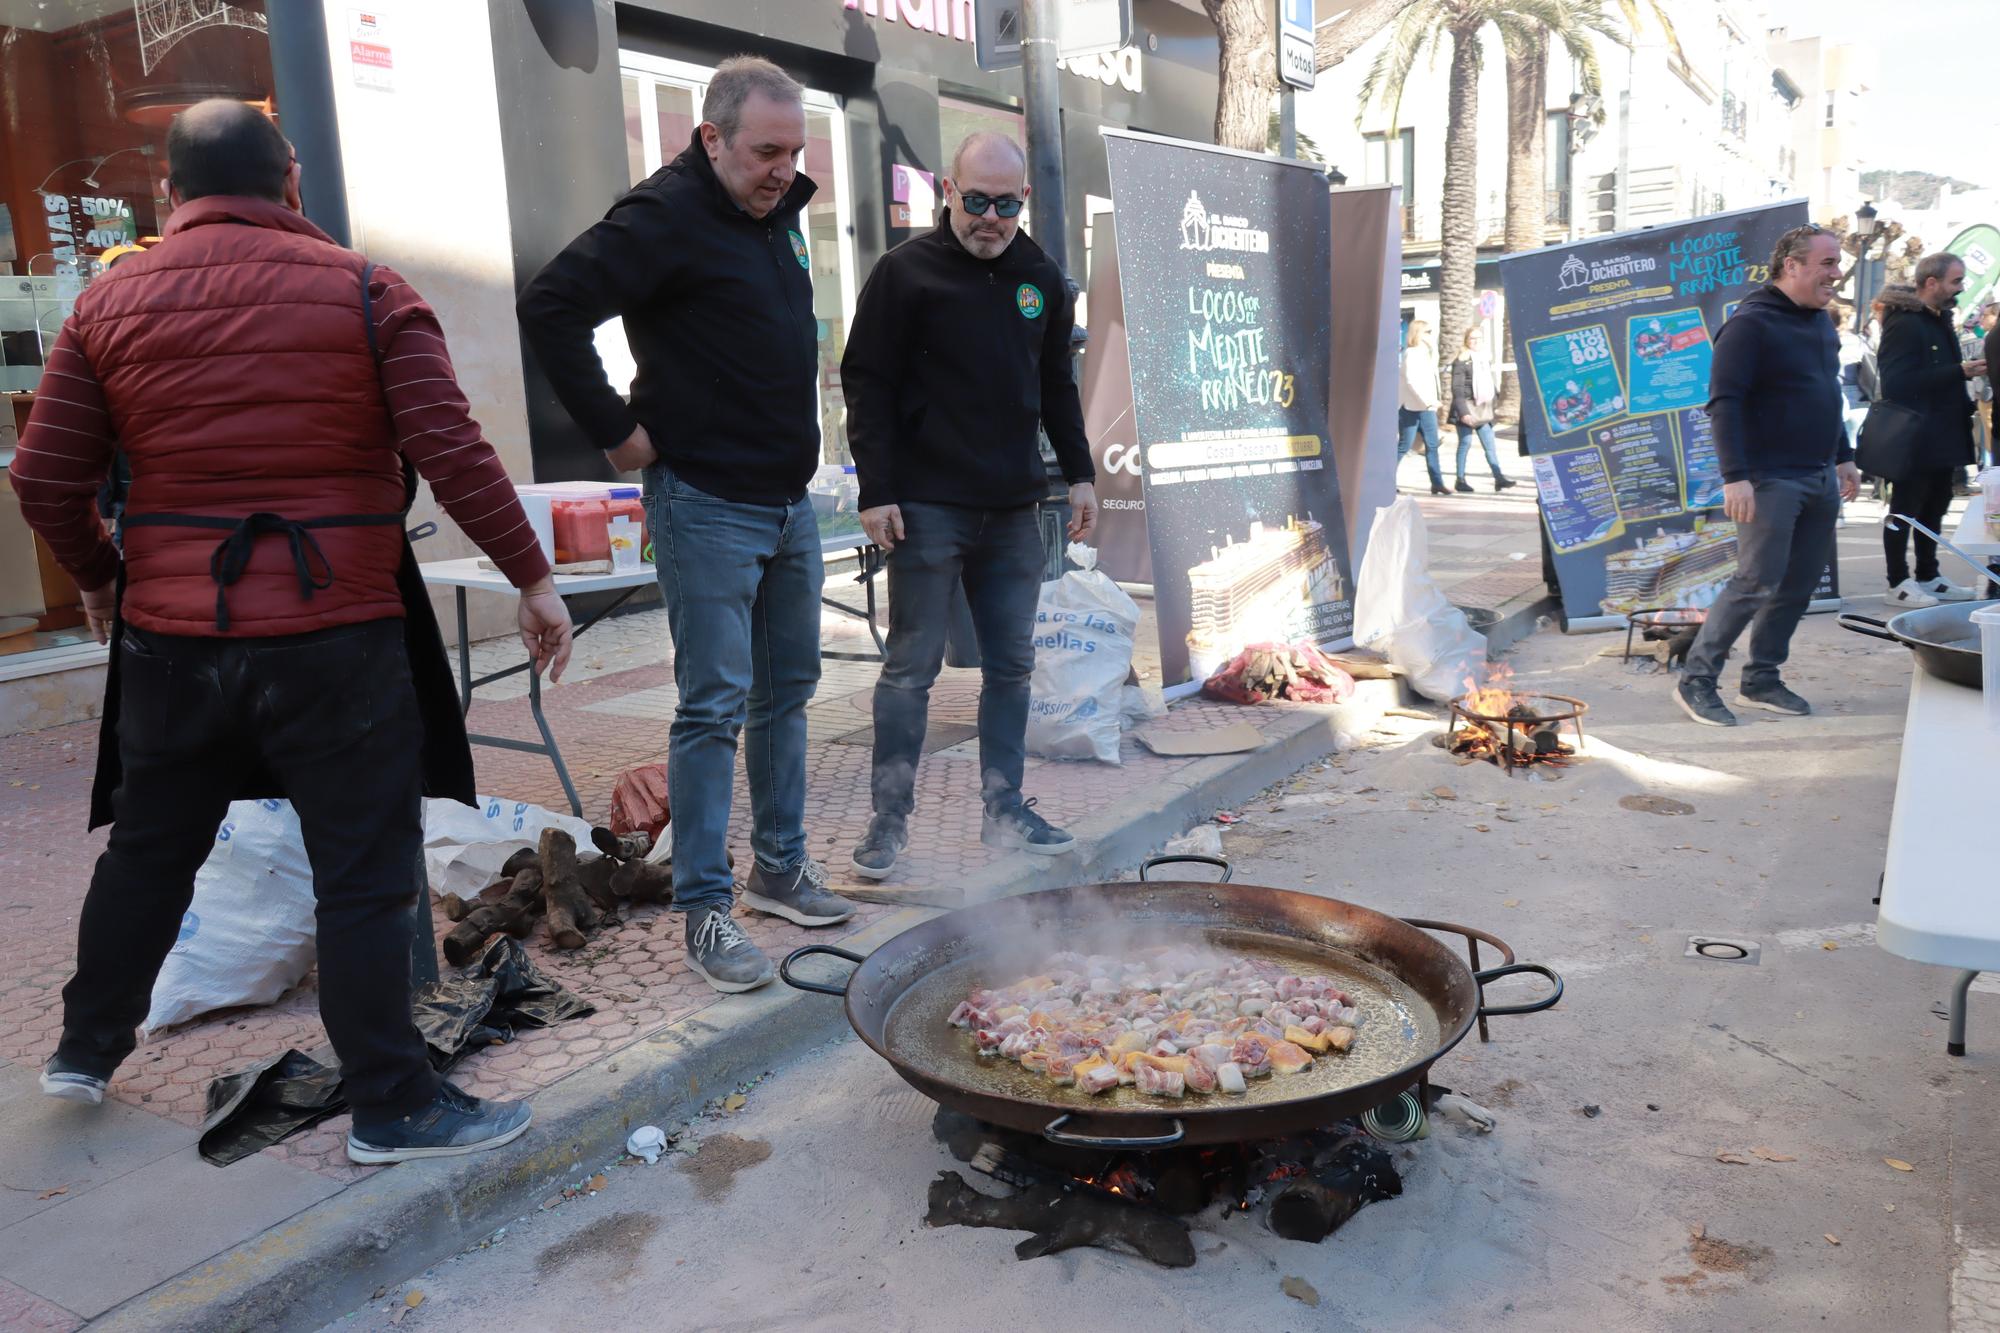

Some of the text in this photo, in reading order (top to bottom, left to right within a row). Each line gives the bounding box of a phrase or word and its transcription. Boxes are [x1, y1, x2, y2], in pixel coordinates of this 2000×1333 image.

[1286, 47, 1312, 74] Motos
[80, 196, 130, 219] 50%
[86, 228, 134, 249] 40%
[1670, 233, 1723, 255] LOCOS
[1592, 257, 1656, 281] OCHENTERO
[1589, 279, 1631, 293] PRESENTA
[1188, 286, 1244, 323] LOCOS
[1565, 327, 1602, 342] PASAJE
[1084, 614, 1116, 634] las
[1034, 632, 1097, 653] aellas
